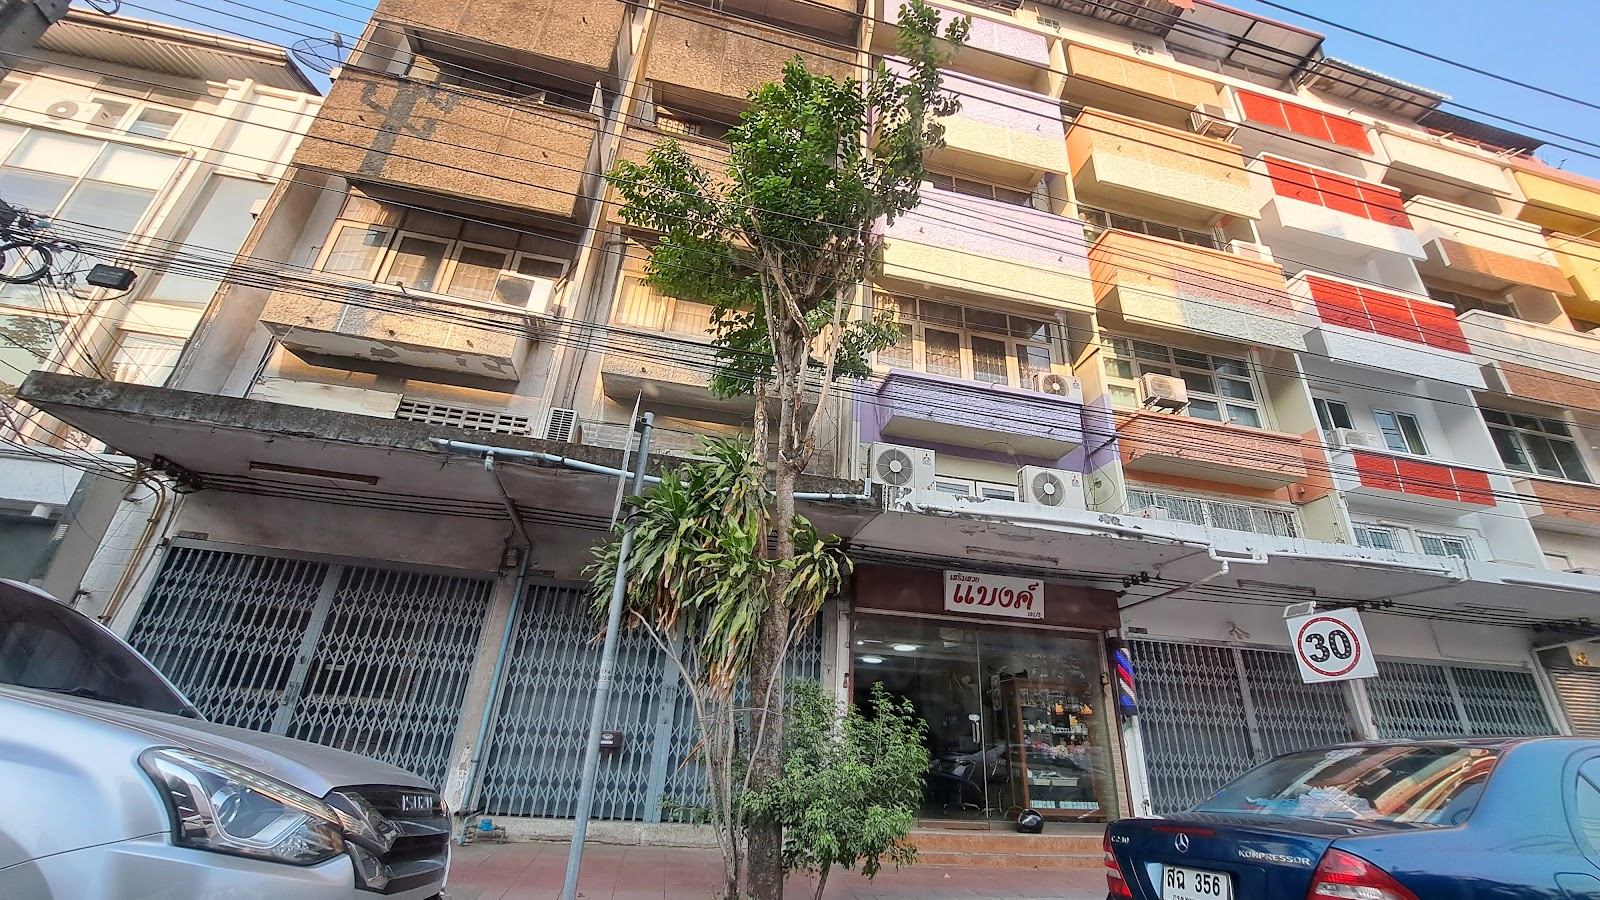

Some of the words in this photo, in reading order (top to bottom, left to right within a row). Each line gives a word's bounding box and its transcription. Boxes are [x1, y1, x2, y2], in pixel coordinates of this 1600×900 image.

[953, 581, 1039, 611] แบงค์
[1305, 629, 1352, 663] 30
[402, 794, 433, 811] ISUZU
[1167, 868, 1185, 890] สฉ
[1195, 873, 1220, 897] 356
